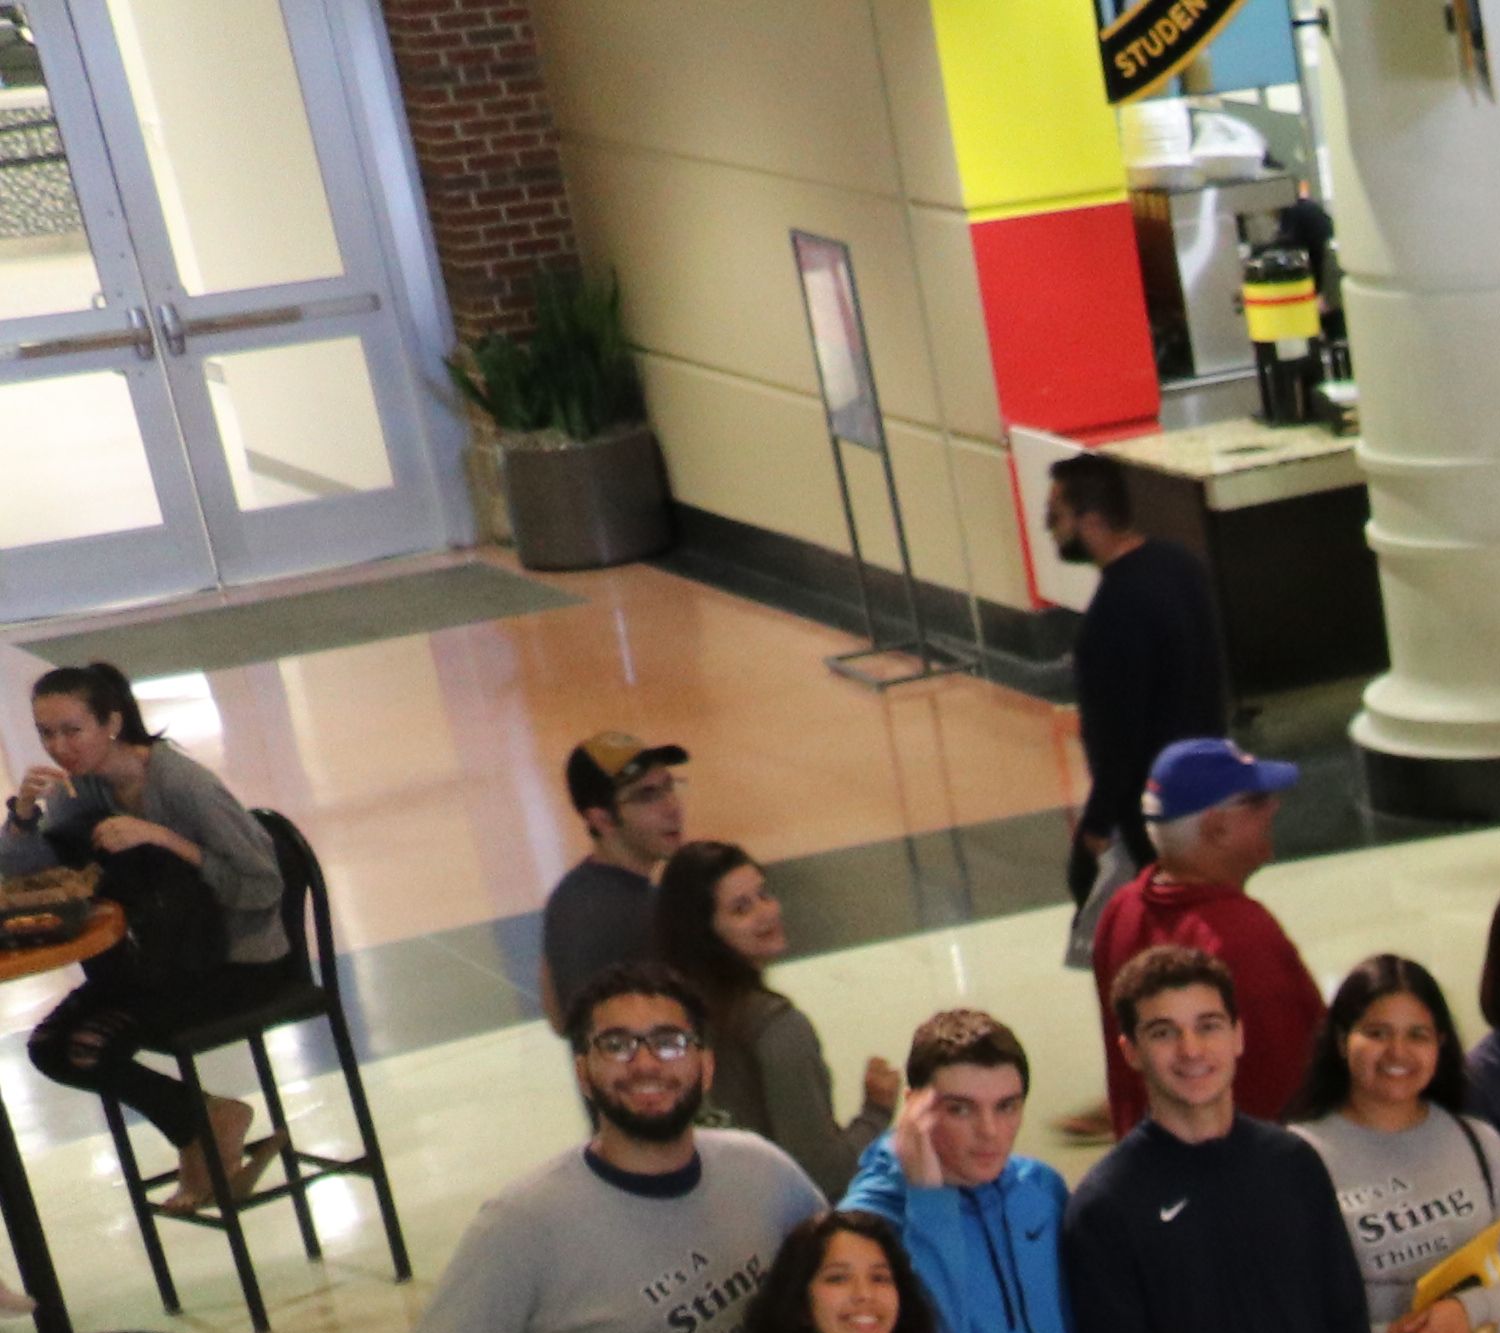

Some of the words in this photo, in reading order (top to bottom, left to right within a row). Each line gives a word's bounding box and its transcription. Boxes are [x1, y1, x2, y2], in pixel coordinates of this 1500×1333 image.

[1391, 1176, 1408, 1193] A
[1358, 1189, 1474, 1243] Sting
[1373, 1236, 1449, 1269] Thing
[643, 1270, 687, 1305] It's
[691, 1252, 709, 1273] A
